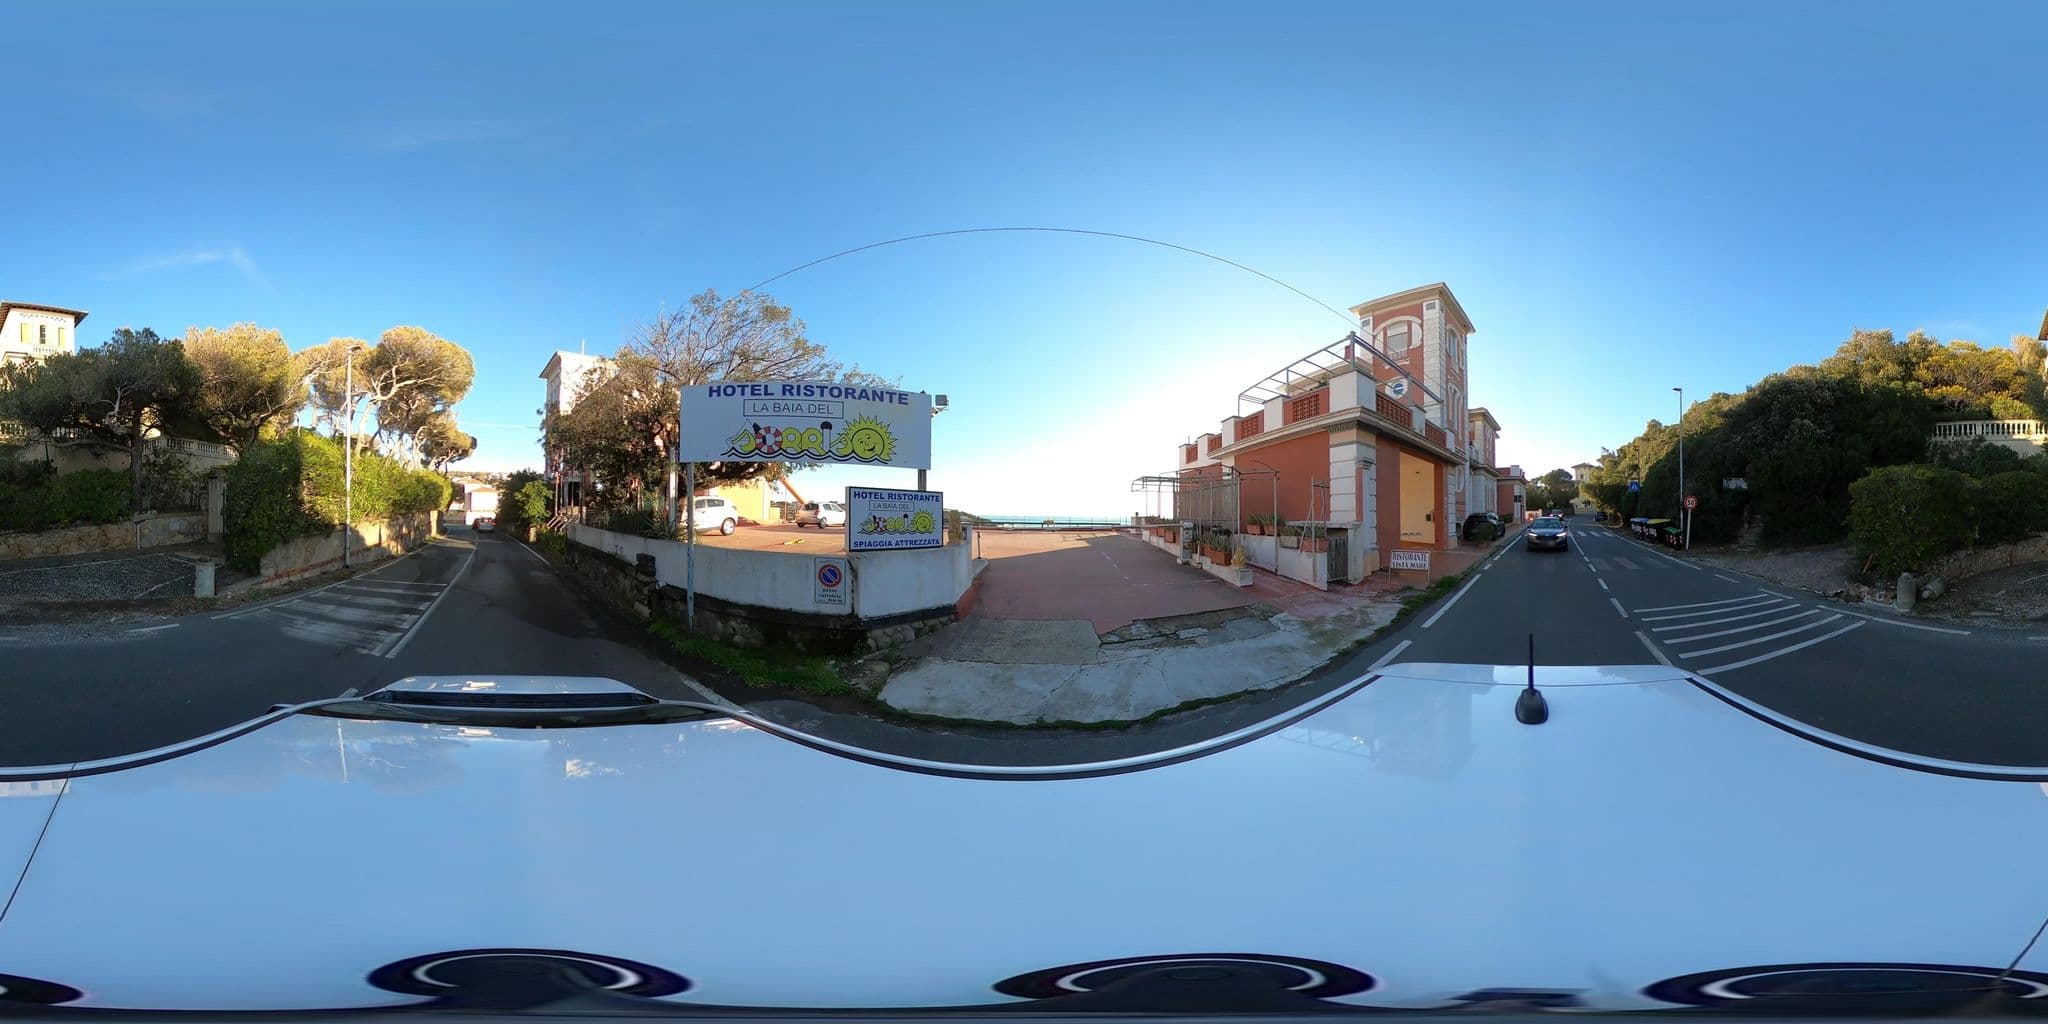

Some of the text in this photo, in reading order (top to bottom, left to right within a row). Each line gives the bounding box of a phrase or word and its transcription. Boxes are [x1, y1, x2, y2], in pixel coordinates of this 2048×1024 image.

[708, 383, 909, 405] HOTEL RISTORANTE
[752, 402, 834, 415] LA BAIA DEL
[853, 491, 940, 502] HOTEL RISTORANTE
[883, 502, 898, 510] BAIA
[853, 539, 940, 548] SPIAGGIA ATTREZZATA
[1392, 552, 1427, 562] RISTORANTE
